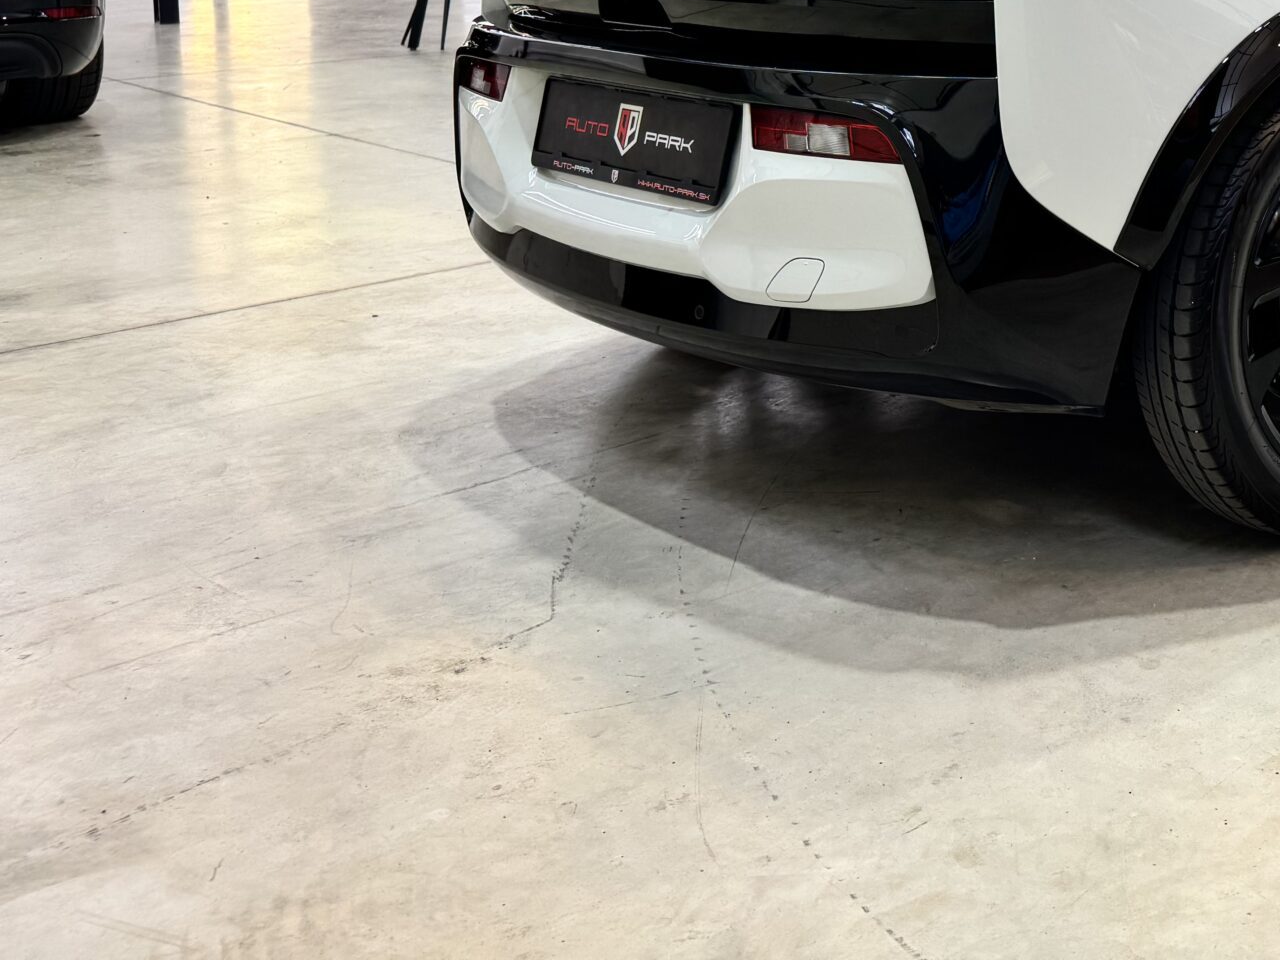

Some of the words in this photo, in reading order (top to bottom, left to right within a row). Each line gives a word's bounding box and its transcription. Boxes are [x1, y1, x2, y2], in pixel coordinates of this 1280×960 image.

[565, 116, 609, 137] AUTO
[643, 130, 695, 154] PARK
[553, 159, 594, 175] AUTO-PARK
